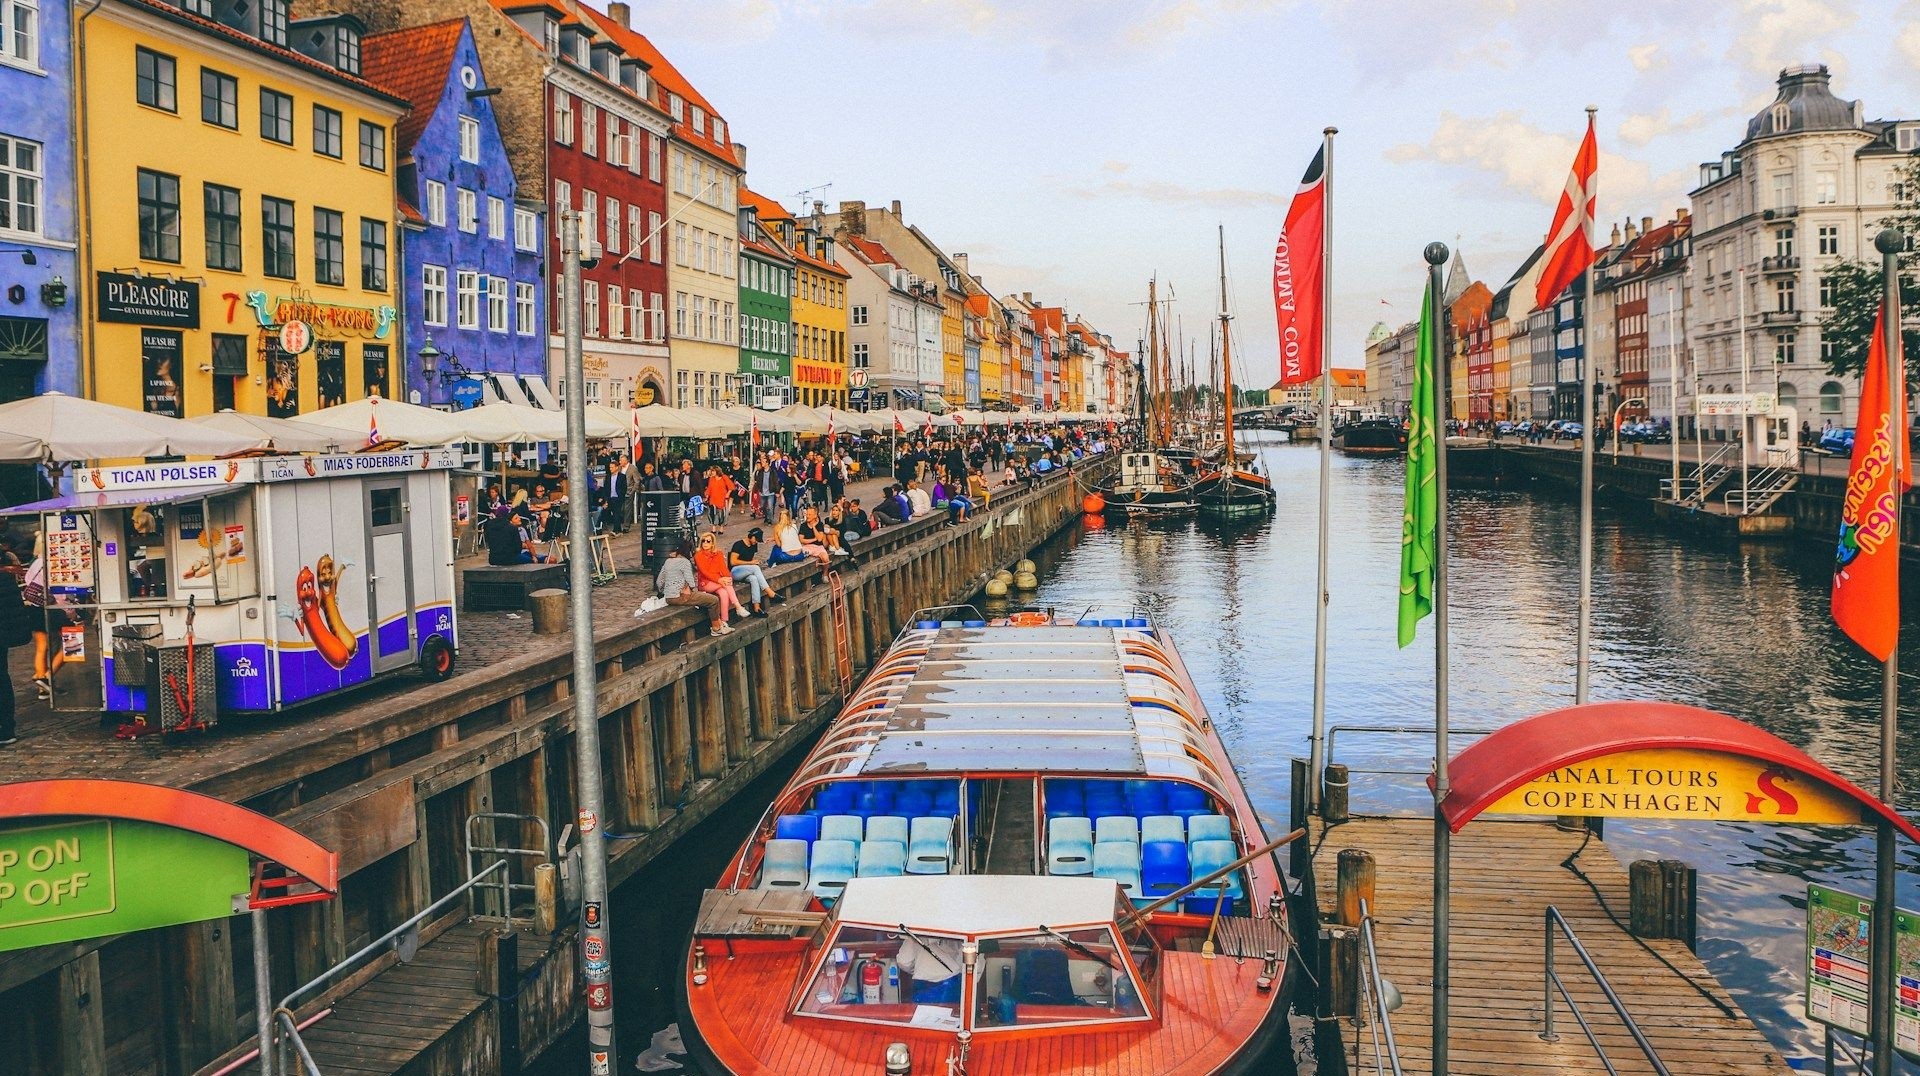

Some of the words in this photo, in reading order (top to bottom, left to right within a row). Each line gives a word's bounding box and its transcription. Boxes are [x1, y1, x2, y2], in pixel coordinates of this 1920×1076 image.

[108, 282, 189, 309] PLEASURE
[222, 292, 241, 324] 7
[143, 336, 177, 347] PLEASURE
[364, 350, 384, 359] PLEASURE
[751, 355, 780, 372] HEERING
[797, 364, 831, 385] NYHAVN
[851, 371, 865, 387] 17
[323, 457, 353, 472] MIA'S
[356, 455, 414, 470] FODERBRÆT
[437, 459, 454, 468] TICAN
[112, 469, 156, 484] TICAN
[161, 465, 217, 481] PØLSER
[271, 469, 294, 479] TICAN
[435, 621, 451, 632] TICAN
[231, 668, 258, 677] TICAN
[1531, 766, 1619, 786] ANAL
[1626, 768, 1719, 788] TOURS
[1523, 791, 1723, 813] COPENHAGEN
[27, 836, 81, 873] ON
[23, 872, 91, 907] OFF
